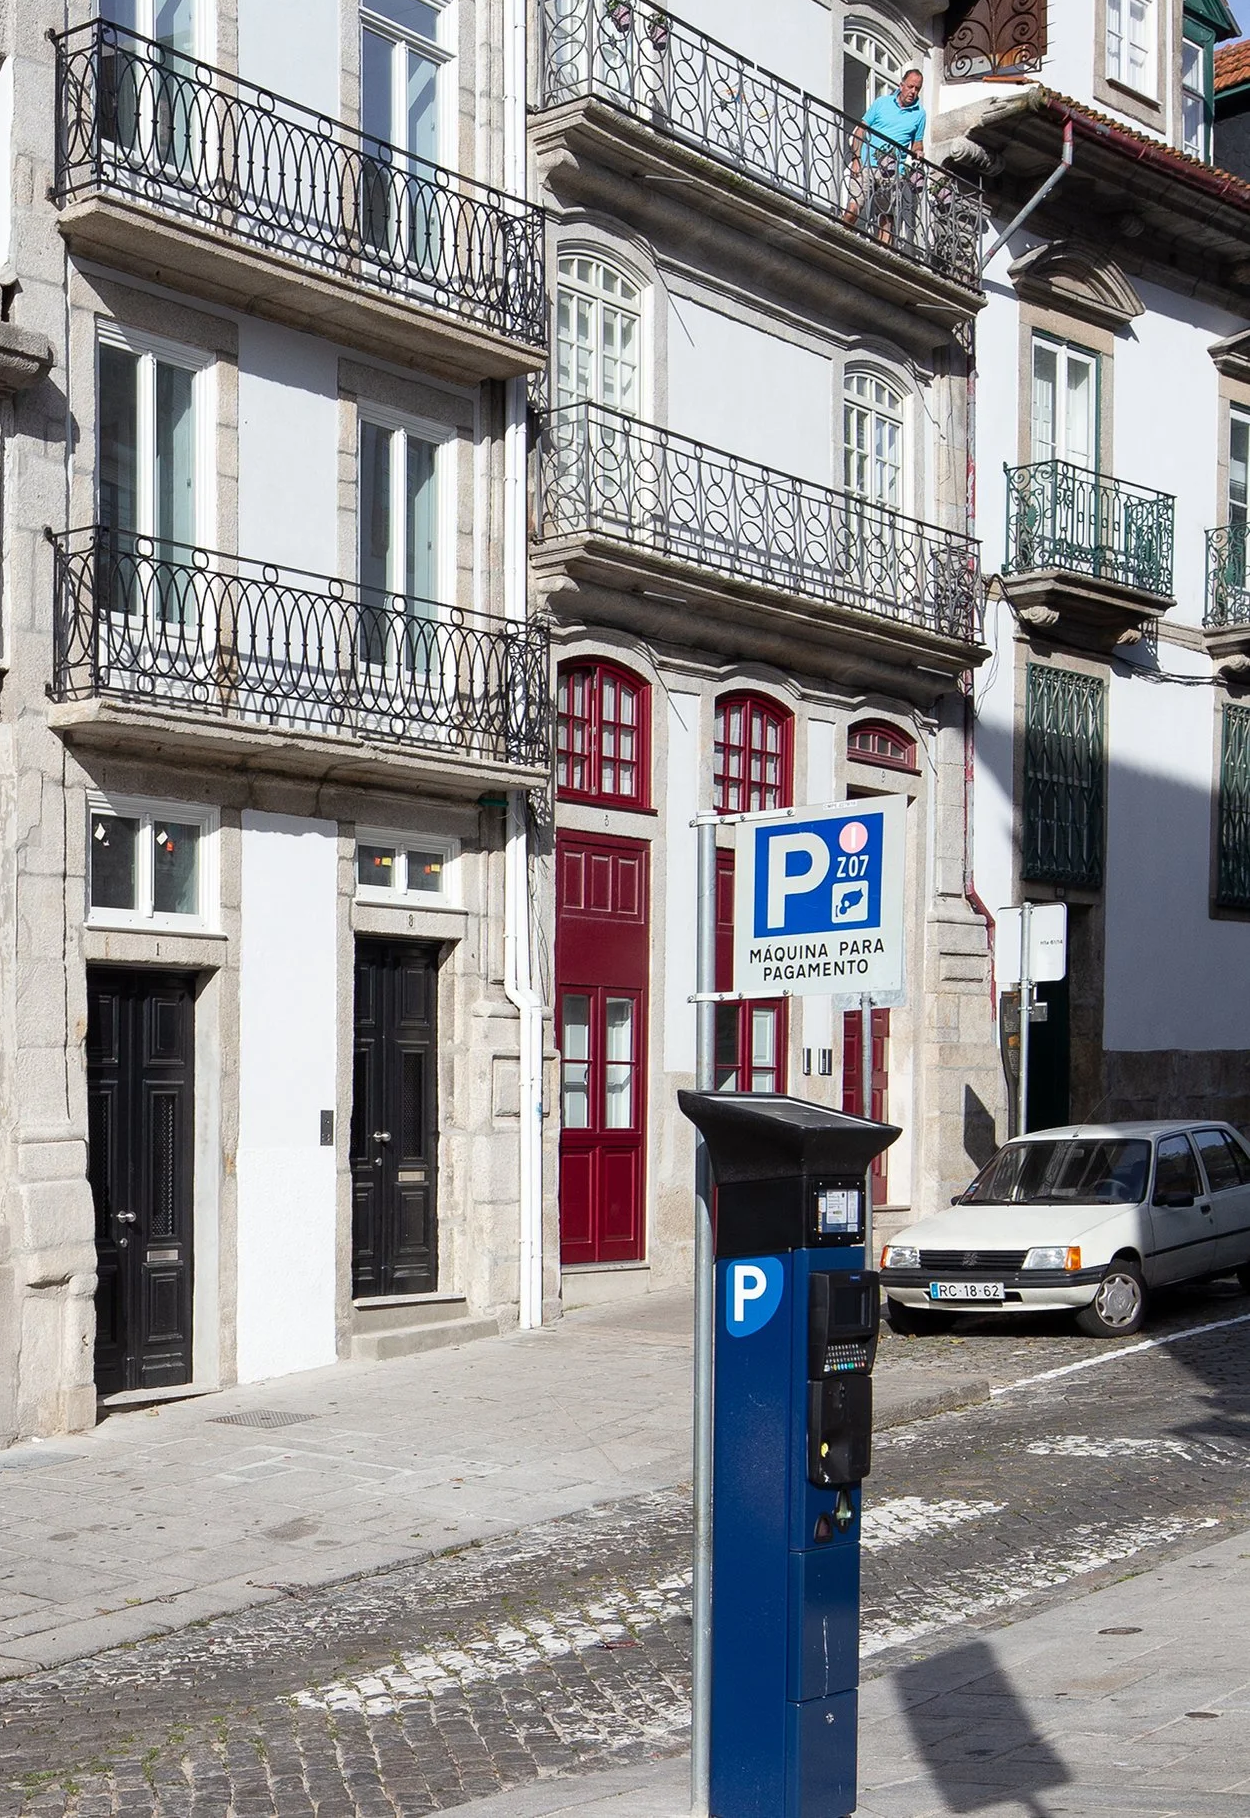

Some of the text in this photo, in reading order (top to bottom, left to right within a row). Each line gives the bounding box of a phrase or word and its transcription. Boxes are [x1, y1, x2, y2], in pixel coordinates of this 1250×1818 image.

[836, 855, 869, 878] Z07
[767, 832, 831, 930] P
[749, 938, 885, 964] MÁQUINA PARA
[763, 959, 869, 982] PAGAMENTO
[733, 1264, 768, 1322] P
